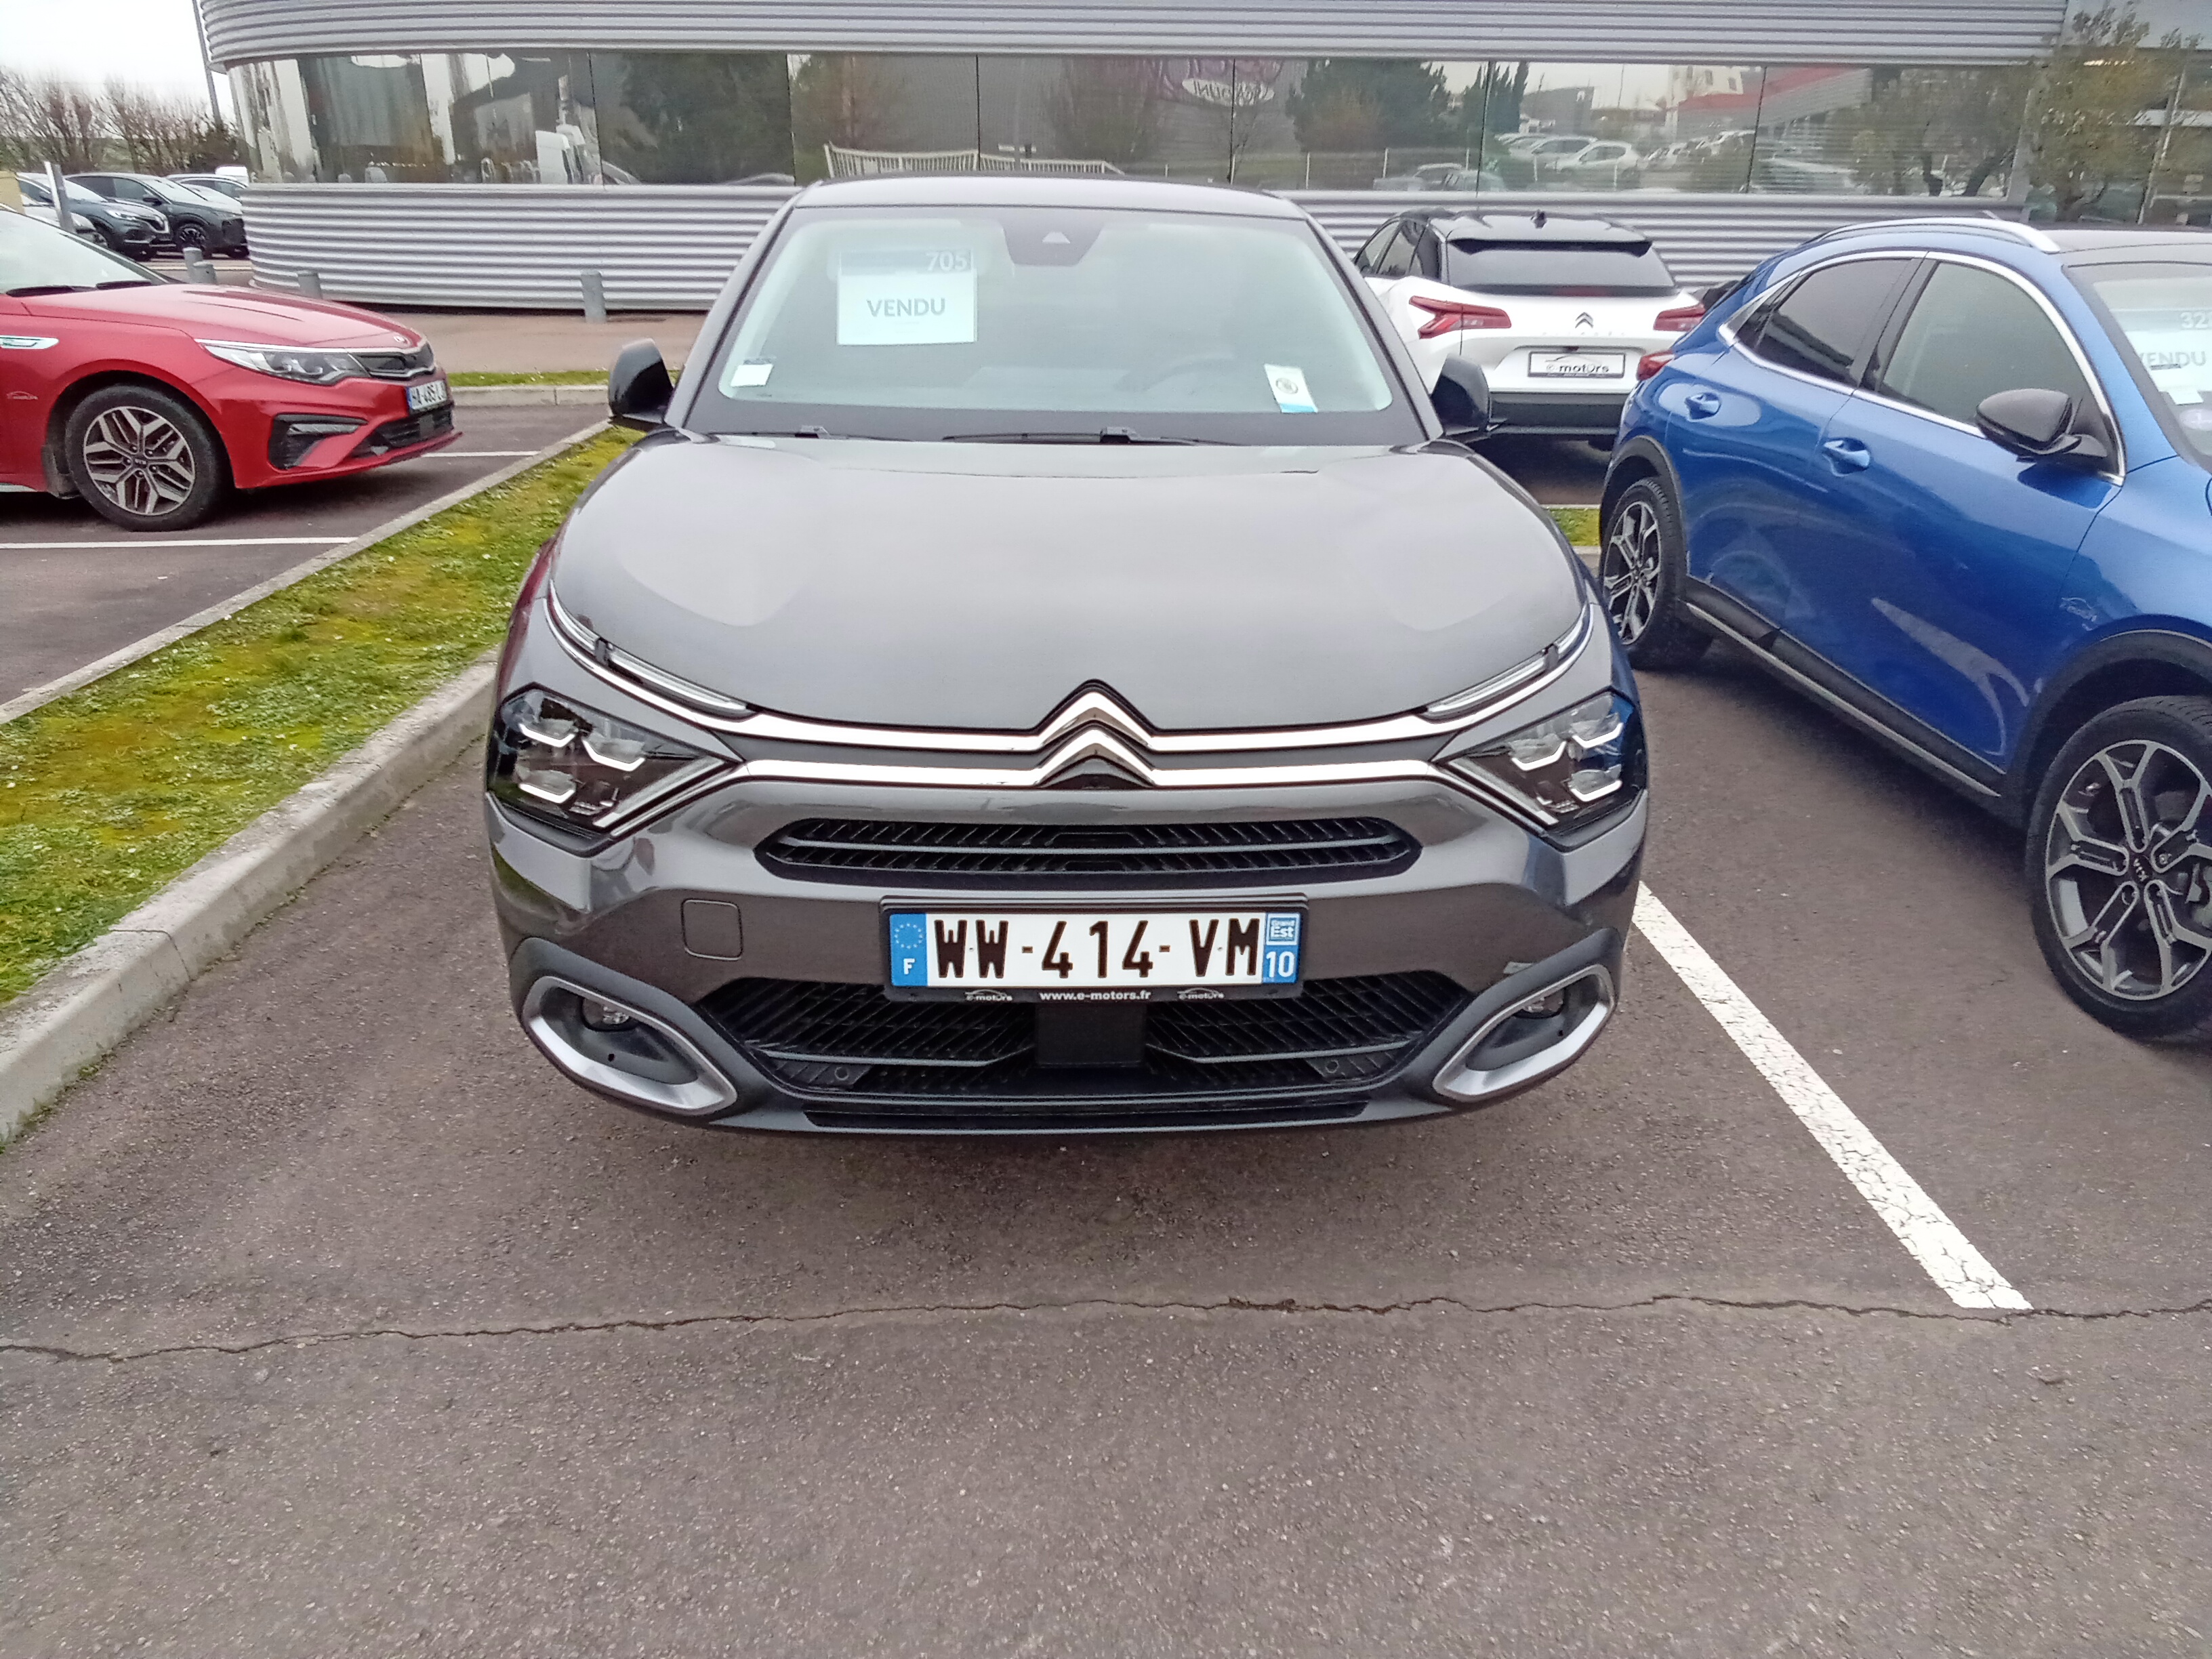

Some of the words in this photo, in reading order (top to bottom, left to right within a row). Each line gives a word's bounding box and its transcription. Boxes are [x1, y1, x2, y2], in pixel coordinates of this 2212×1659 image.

[926, 251, 967, 271] 705
[866, 298, 945, 317] VENDU
[2180, 312, 2212, 329] 32
[1270, 926, 1294, 938] Est
[934, 918, 1260, 979] WW-414-VM
[903, 958, 916, 975] F
[1266, 951, 1295, 978] 10
[1040, 990, 1151, 1000] www.e-motors.fr
